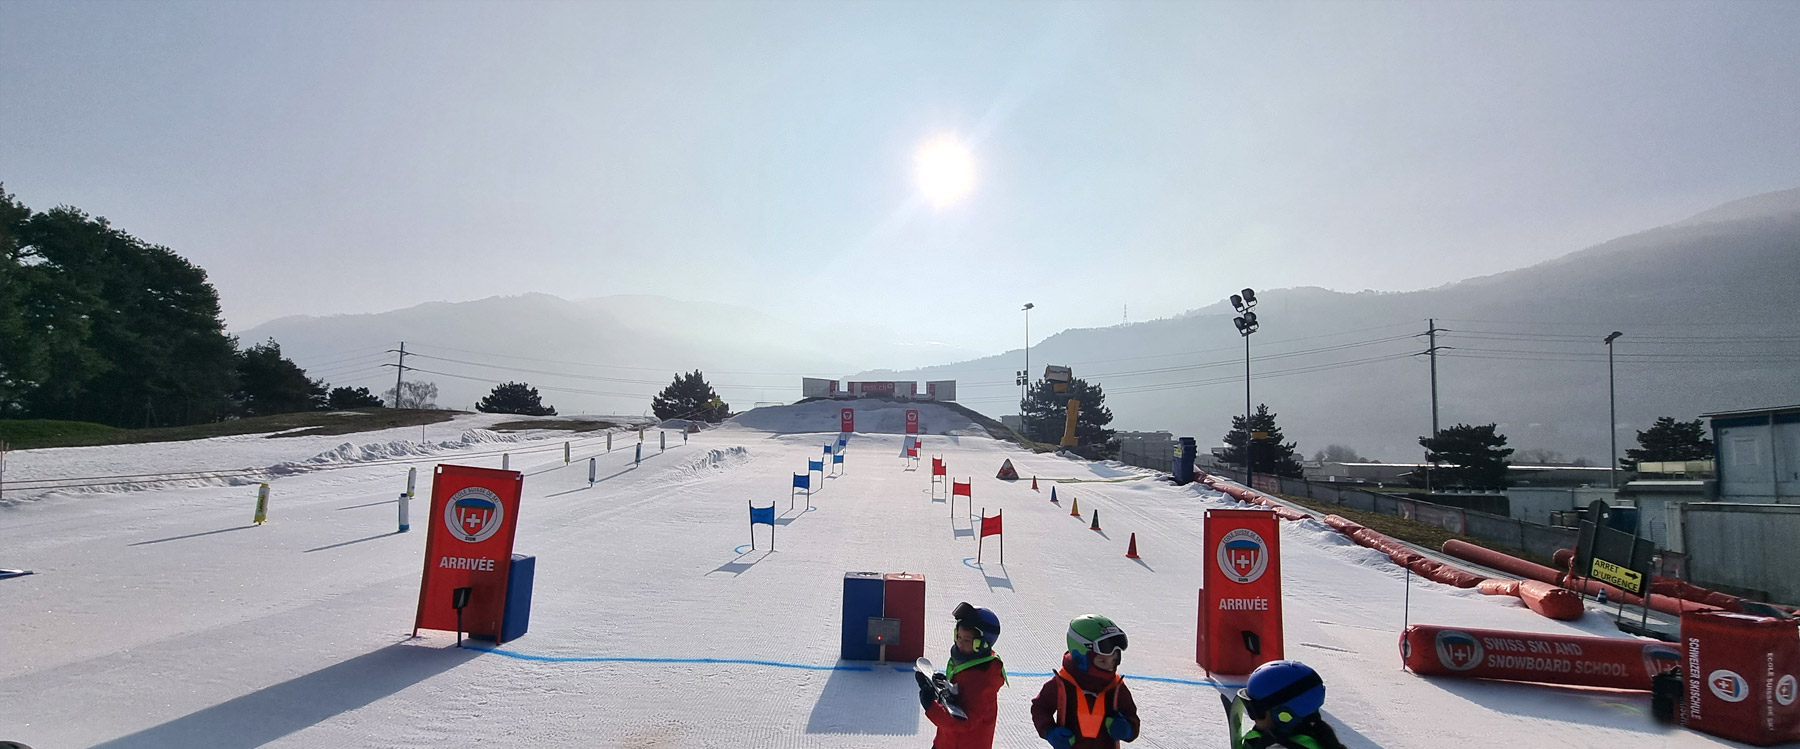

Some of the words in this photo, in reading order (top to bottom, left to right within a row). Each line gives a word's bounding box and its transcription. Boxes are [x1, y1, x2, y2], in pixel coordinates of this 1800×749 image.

[440, 556, 495, 571] ARRIVÉE
[1594, 559, 1620, 573] ARRET
[1593, 569, 1639, 591] D'URGENCE
[1219, 596, 1269, 610] ARRIVÉE
[1483, 637, 1526, 652] SWISS
[1527, 640, 1552, 654] SKI
[1554, 642, 1583, 656] AND
[1488, 654, 1571, 673] SNOWBOARD
[1575, 660, 1630, 677] SCHOOL
[1689, 637, 1700, 678] SCHWEIZER
[1767, 652, 1775, 676] ECOLE
[1690, 678, 1701, 719] SKISCHULE
[1767, 706, 1774, 717] DE
